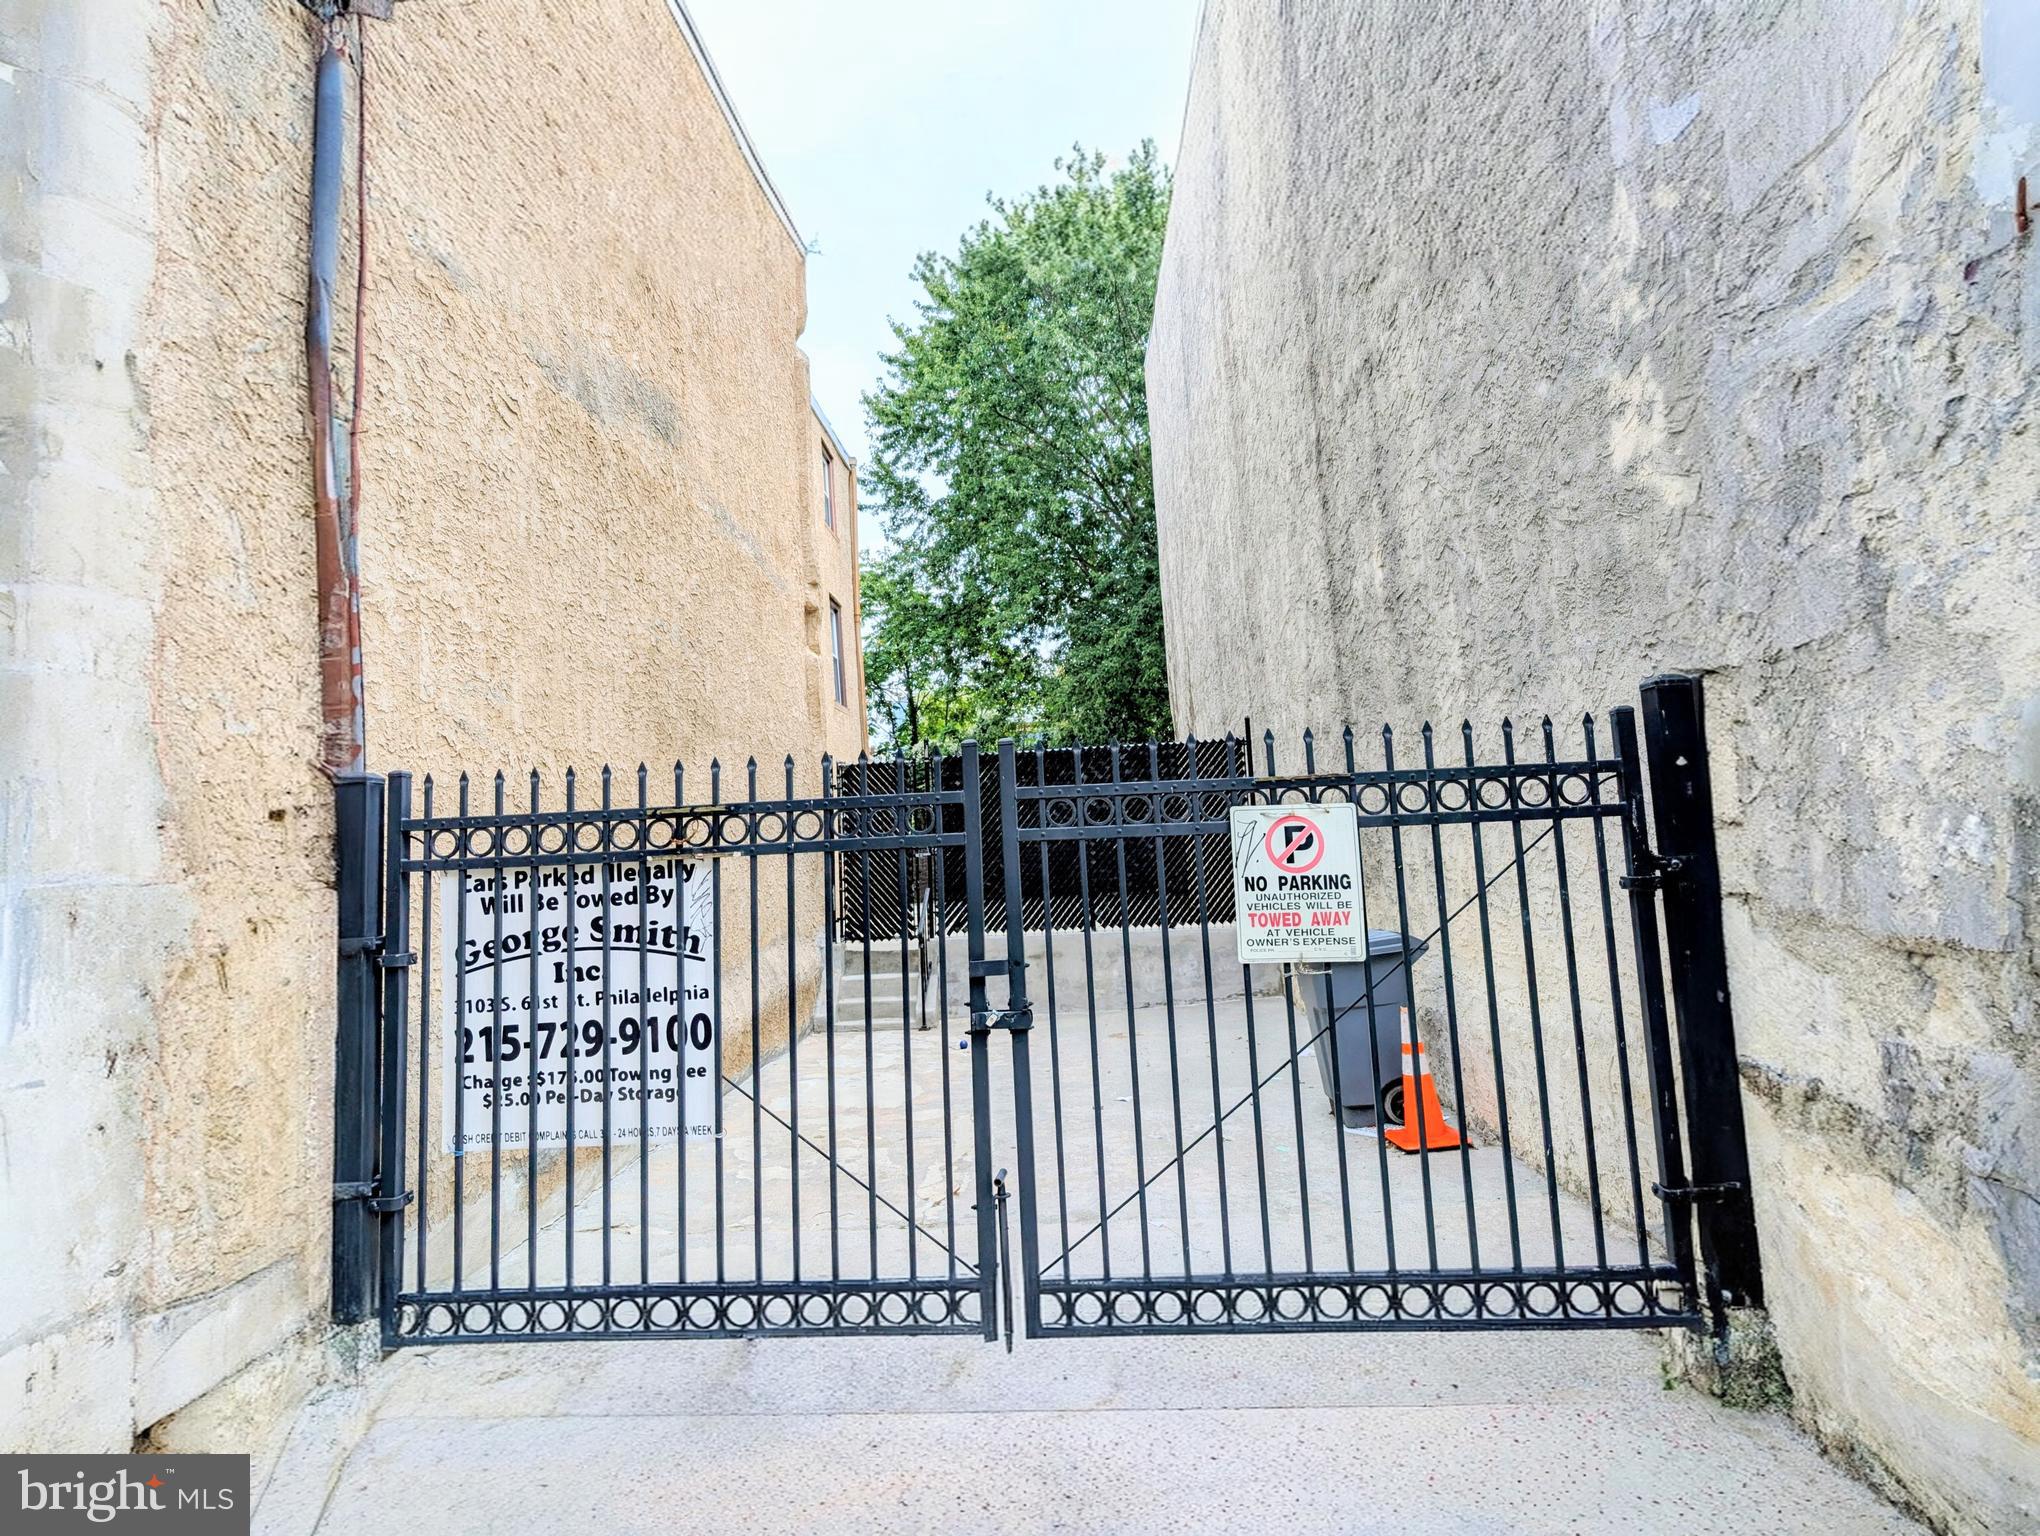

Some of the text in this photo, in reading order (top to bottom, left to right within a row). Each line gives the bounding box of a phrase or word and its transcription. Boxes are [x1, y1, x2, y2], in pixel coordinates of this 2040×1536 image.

[1244, 873, 1352, 892] NO PARKING
[480, 893, 523, 915] Will
[645, 885, 674, 908] By
[1246, 900, 1353, 911] VEHICLES WILL BE
[1255, 891, 1342, 902] UNAUTHORIZED
[1248, 911, 1351, 928] TOWED AWAY
[455, 916, 701, 967] George Smith
[1246, 936, 1356, 947] OWNER'S EXPENSE
[1266, 927, 1335, 937] AT VEHICLE
[455, 998, 495, 1014] 103
[521, 995, 558, 1011] 6st
[572, 993, 590, 1008] t.
[455, 1012, 712, 1064] 215-729-9100
[463, 1073, 523, 1092] Chage
[610, 1067, 672, 1084] Towng
[677, 1065, 707, 1079] ee
[618, 1086, 682, 1103] Storag
[504, 1131, 526, 1143] DEBIT
[578, 1128, 598, 1140] CALL
[691, 1124, 713, 1137] WEEK
